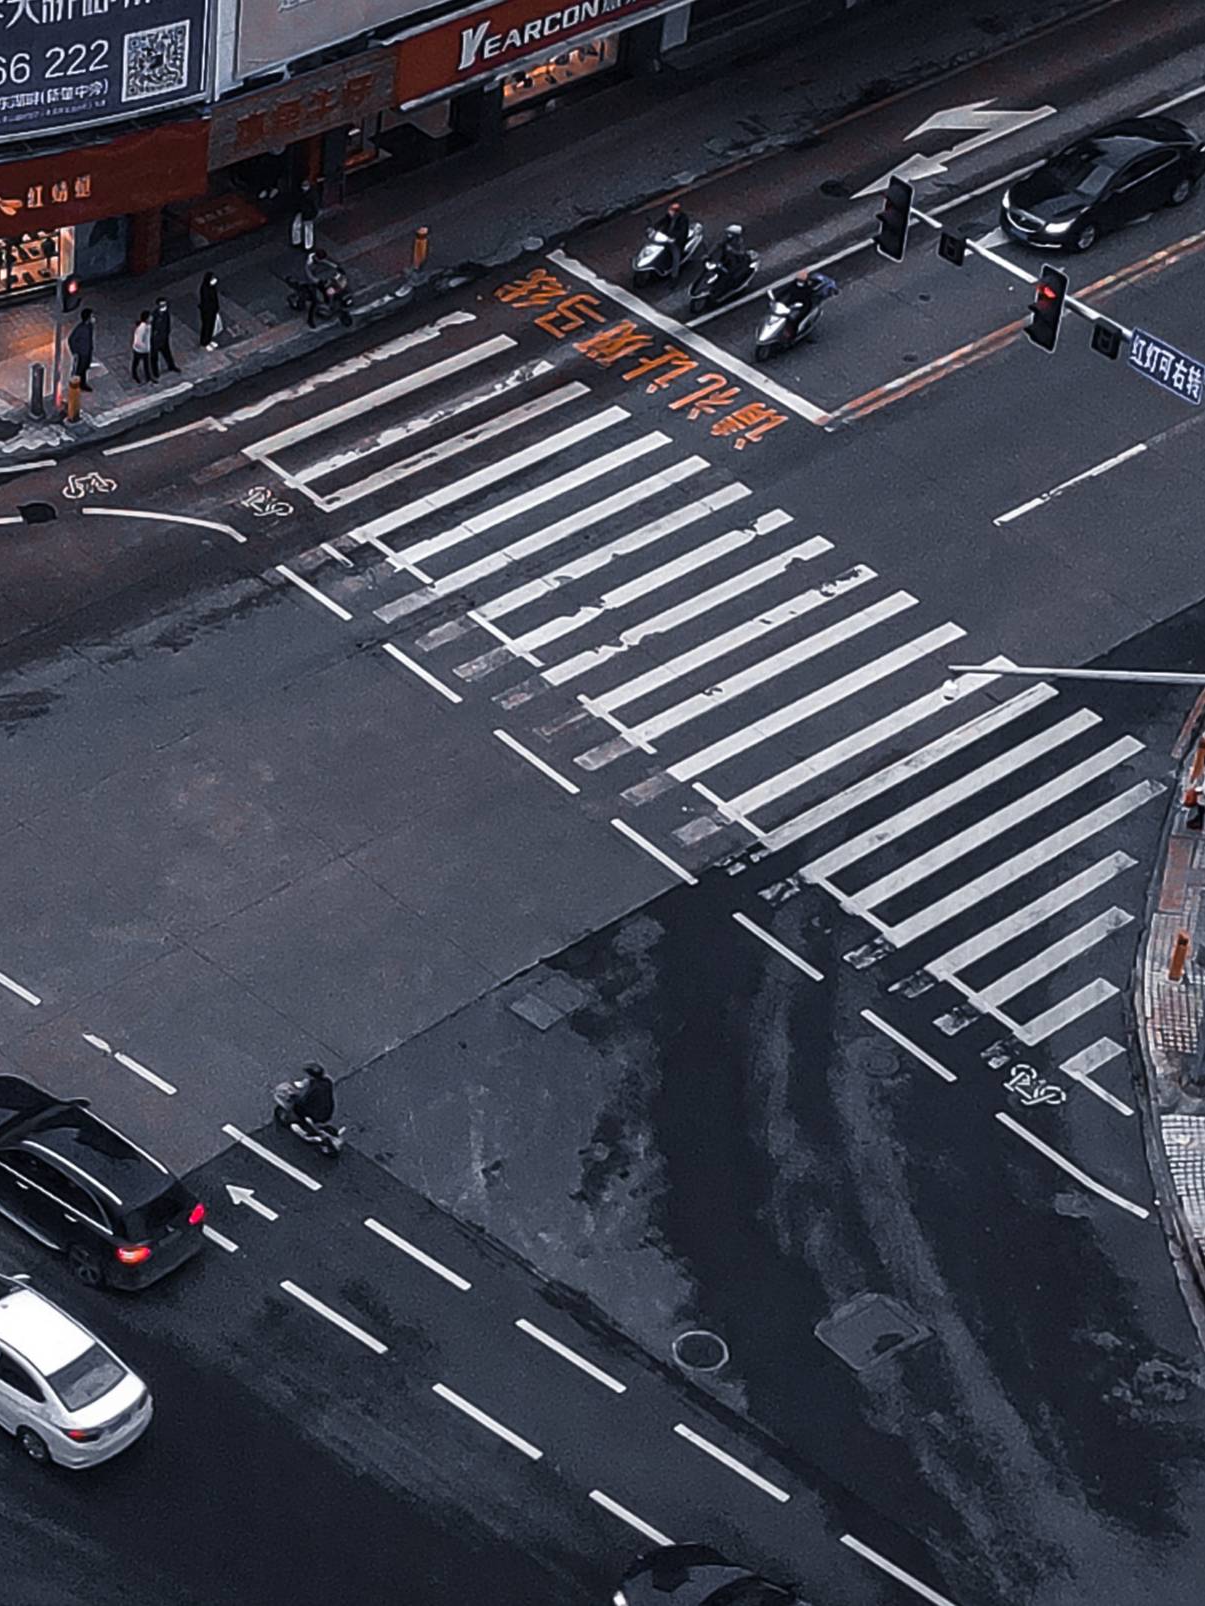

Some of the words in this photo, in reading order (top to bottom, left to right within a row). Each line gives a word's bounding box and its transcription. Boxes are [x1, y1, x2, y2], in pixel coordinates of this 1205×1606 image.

[44, 39, 110, 79] 222
[458, 0, 600, 71] YEARCON
[1129, 334, 1203, 400] 红灯可右转
